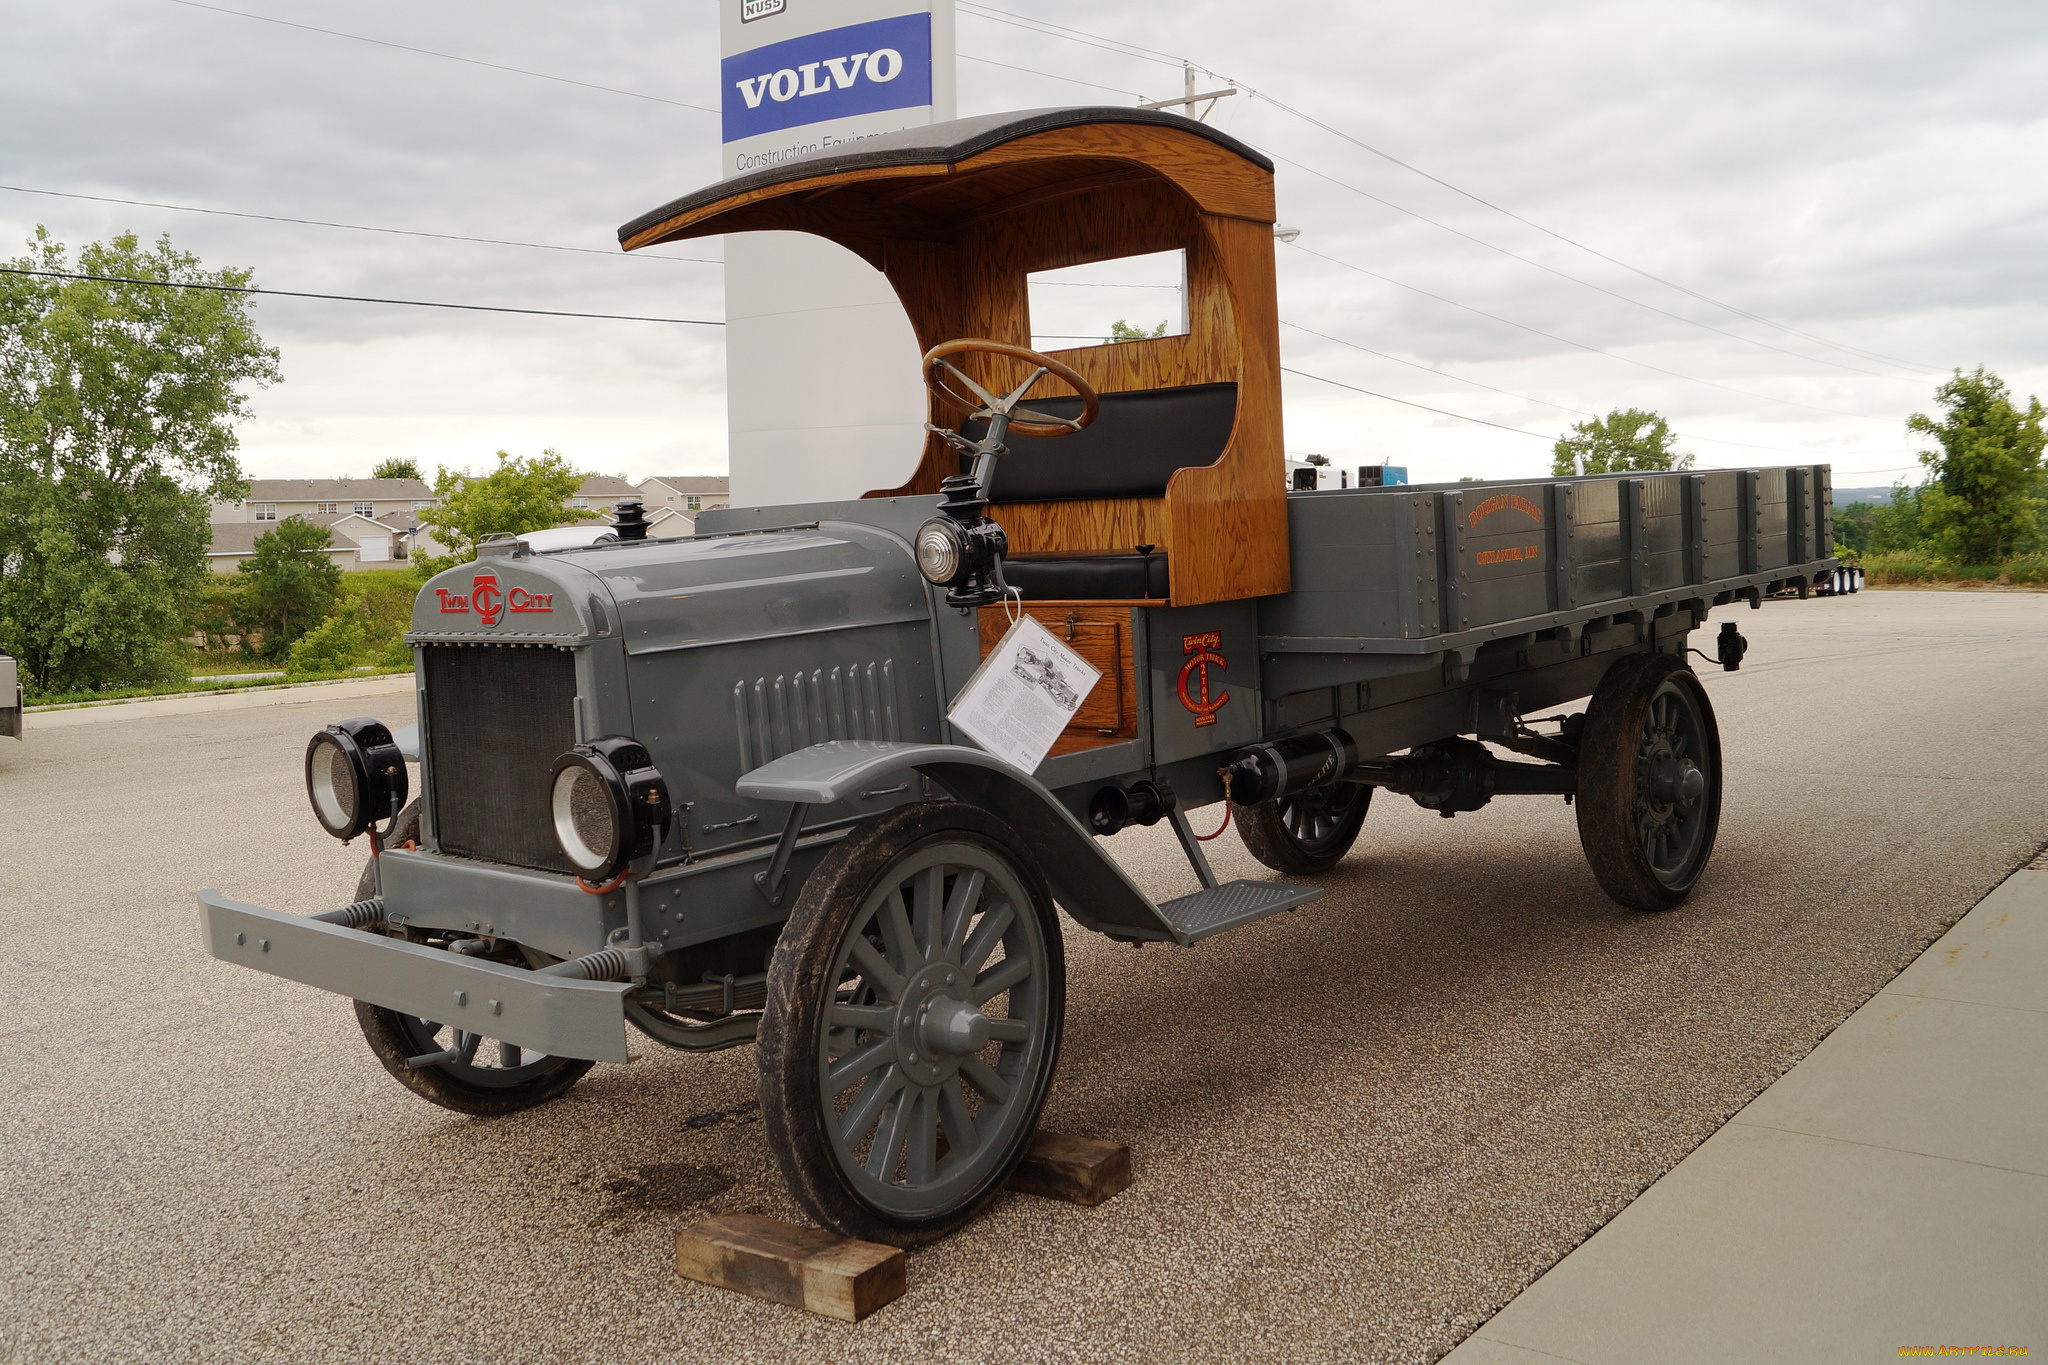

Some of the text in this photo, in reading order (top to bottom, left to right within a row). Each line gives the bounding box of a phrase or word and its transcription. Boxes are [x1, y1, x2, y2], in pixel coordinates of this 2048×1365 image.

[745, 0, 781, 16] NUSS
[736, 48, 902, 109] VOLVO
[1468, 494, 1542, 528] DOUGAN FARMS
[1525, 545, 1538, 559] MN
[1200, 664, 1206, 675] 2
